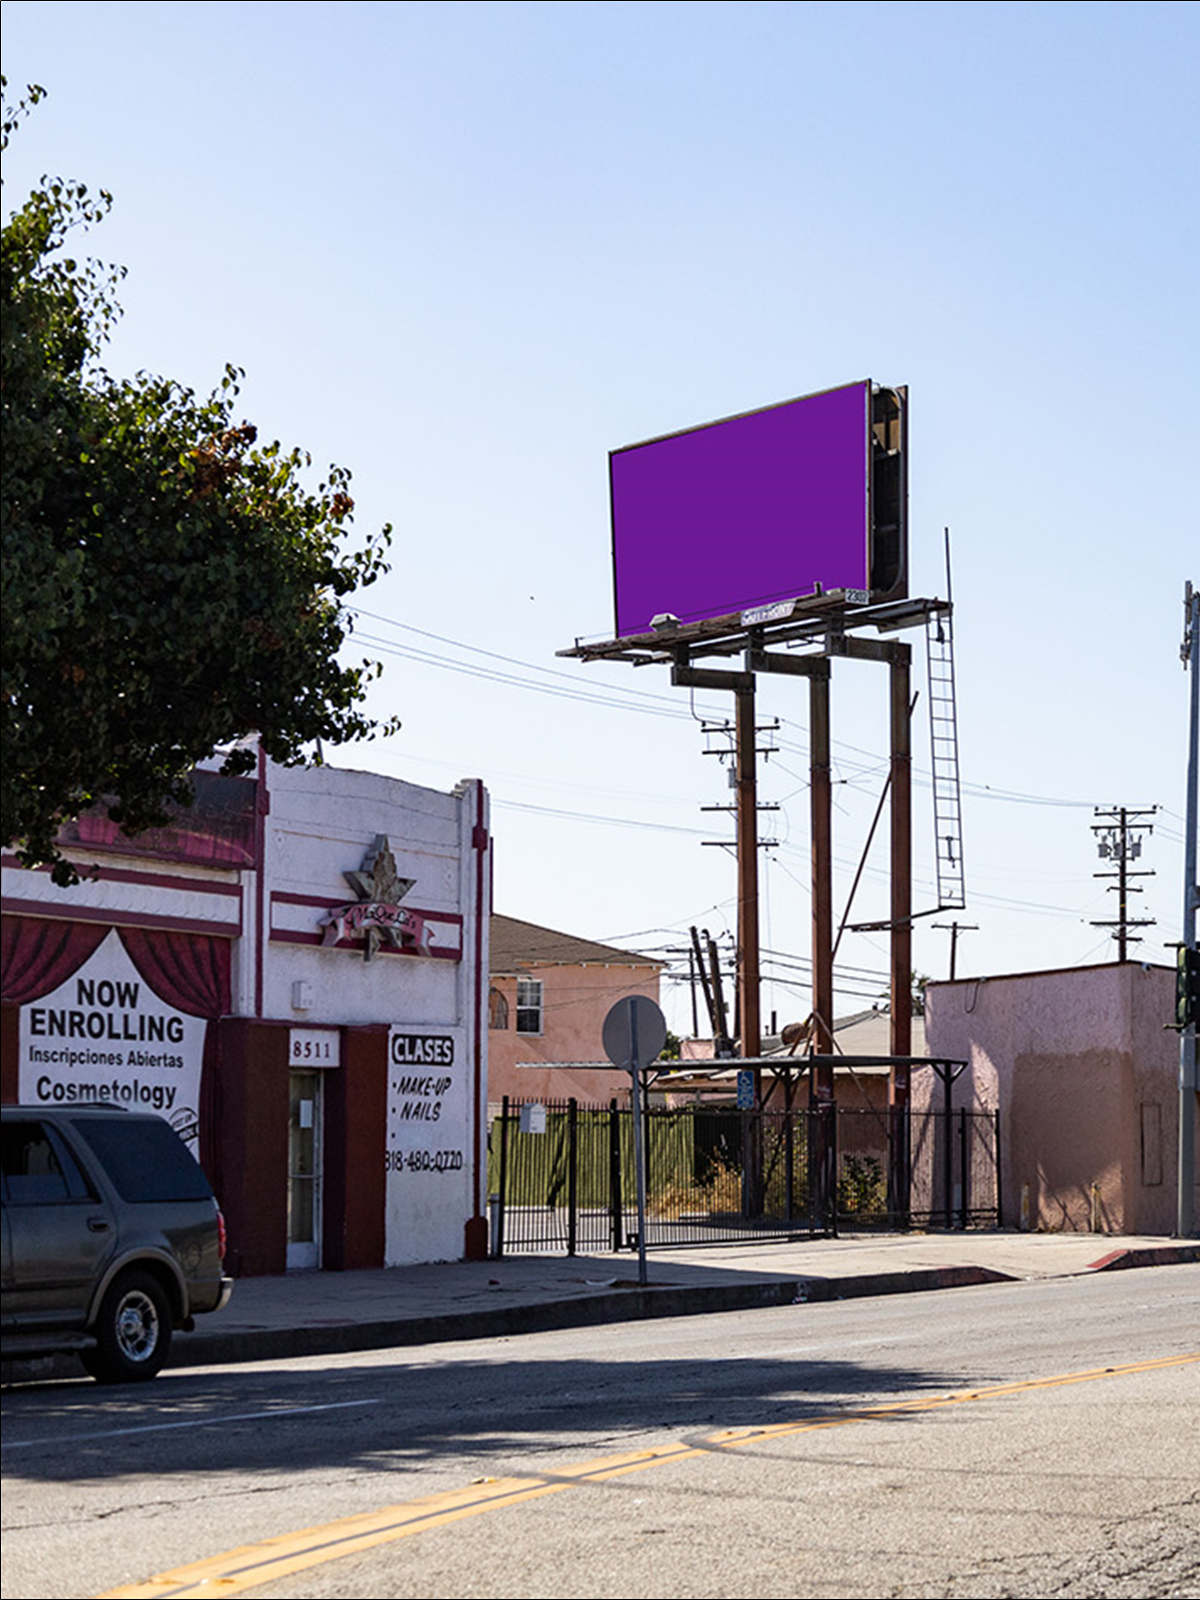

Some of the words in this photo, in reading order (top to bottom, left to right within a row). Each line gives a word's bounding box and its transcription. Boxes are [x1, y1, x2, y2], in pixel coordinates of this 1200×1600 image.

[77, 978, 139, 1009] NOW
[30, 1009, 184, 1043] ENROLLING
[29, 1046, 123, 1067] Inscripciones
[127, 1050, 183, 1069] Abiertas
[293, 1041, 330, 1058] 8511
[393, 1037, 453, 1064] CLASES
[36, 1075, 177, 1110] Cosmetology
[397, 1076, 452, 1096] MAKE-UP
[400, 1102, 442, 1122] NAILS
